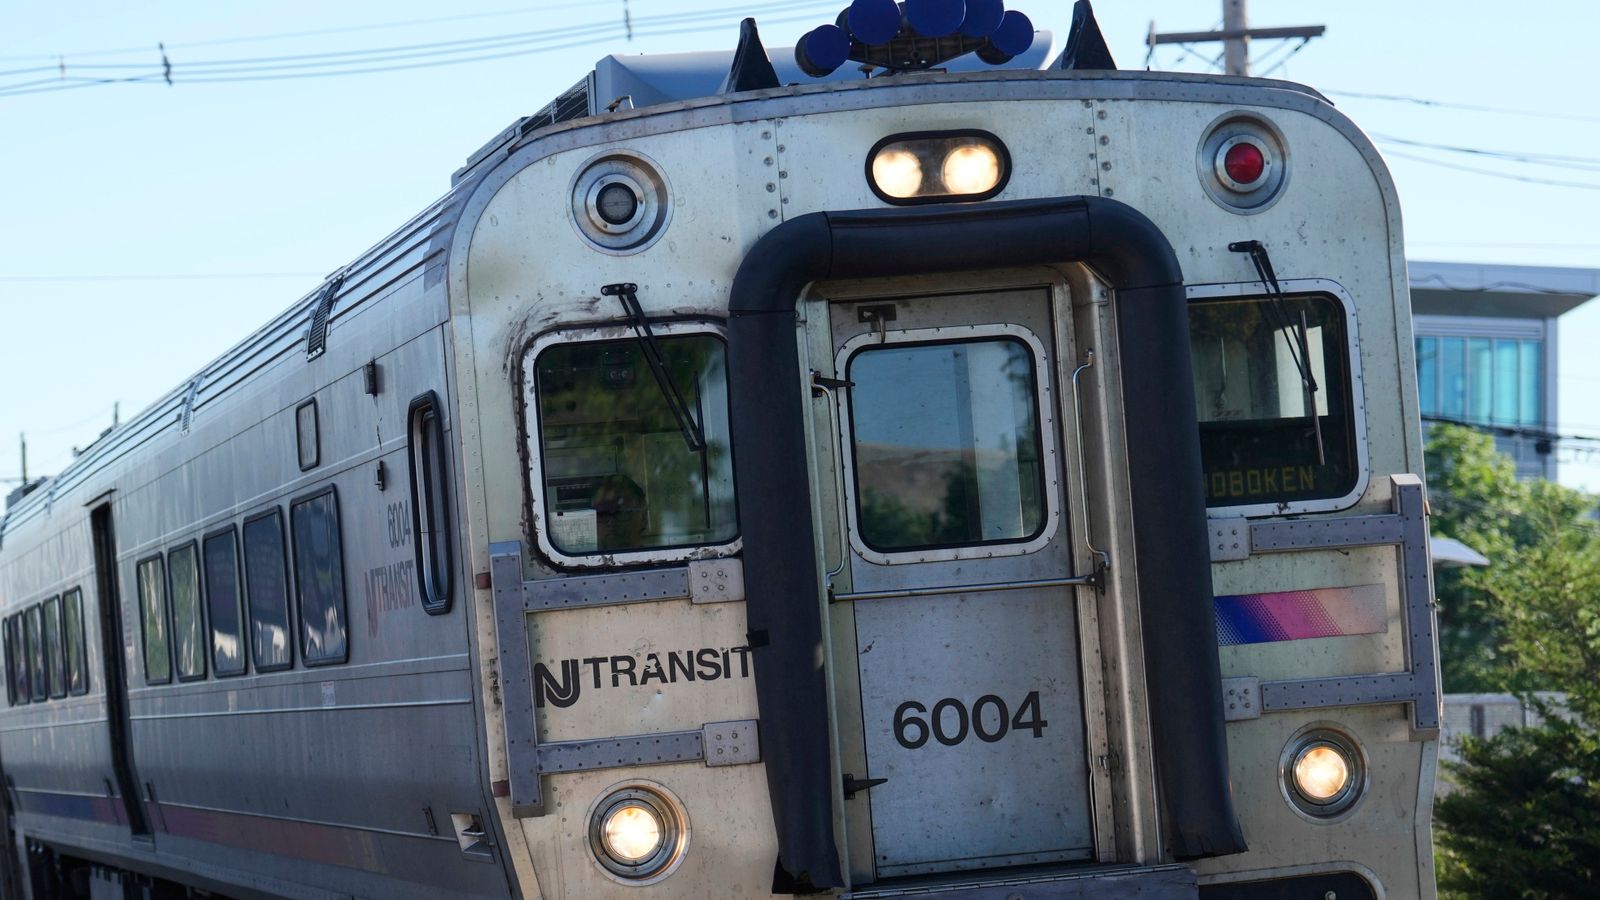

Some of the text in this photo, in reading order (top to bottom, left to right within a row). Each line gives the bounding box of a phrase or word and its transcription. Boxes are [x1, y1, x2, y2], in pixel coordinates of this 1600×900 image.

[388, 499, 411, 548] 6004
[375, 560, 415, 613] TRANSIT
[534, 646, 753, 708] NJ TRANSIT
[893, 690, 1048, 750] 6004
